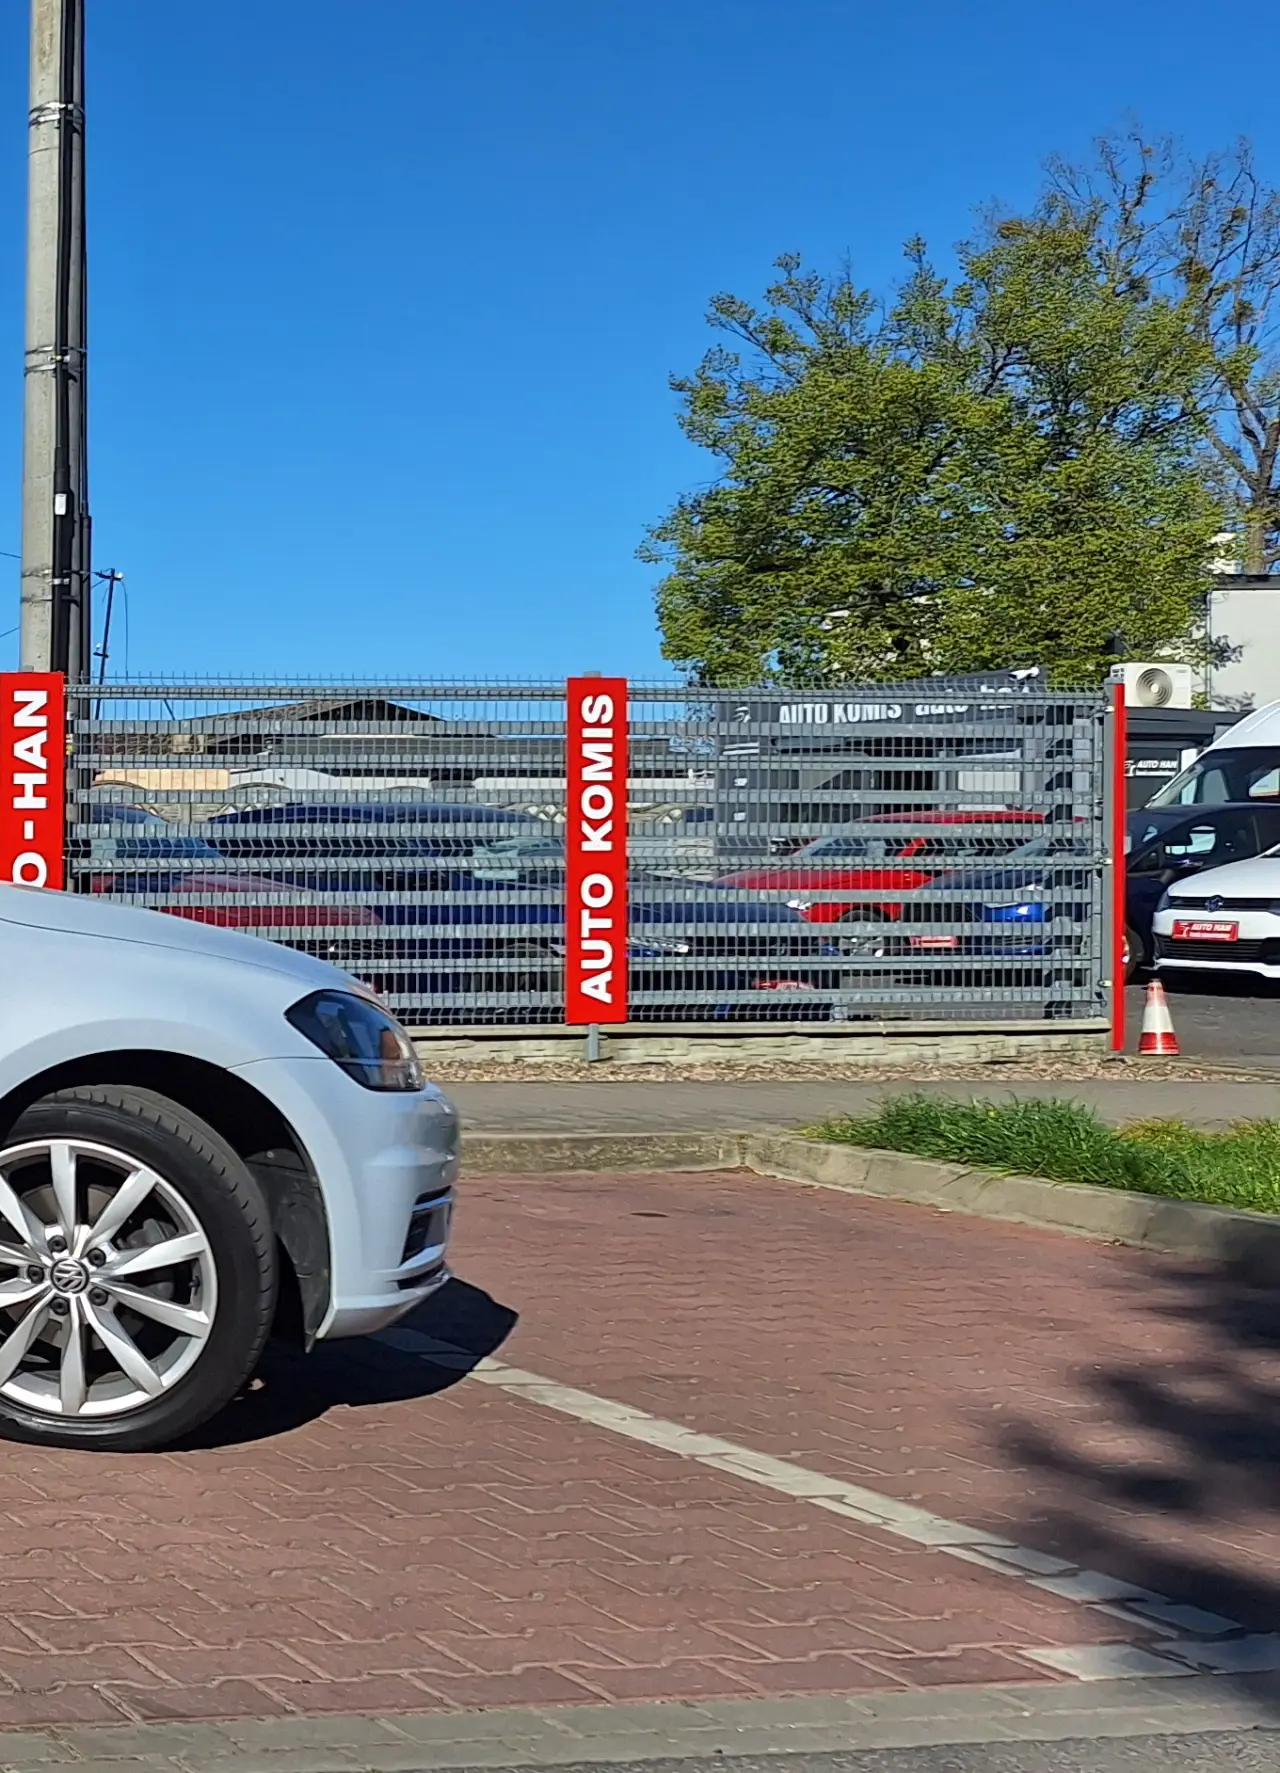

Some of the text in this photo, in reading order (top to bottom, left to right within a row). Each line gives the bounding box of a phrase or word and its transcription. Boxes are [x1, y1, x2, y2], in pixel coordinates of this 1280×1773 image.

[1137, 760, 1159, 769] AUTO
[580, 694, 614, 1004] AUTO KOMIS
